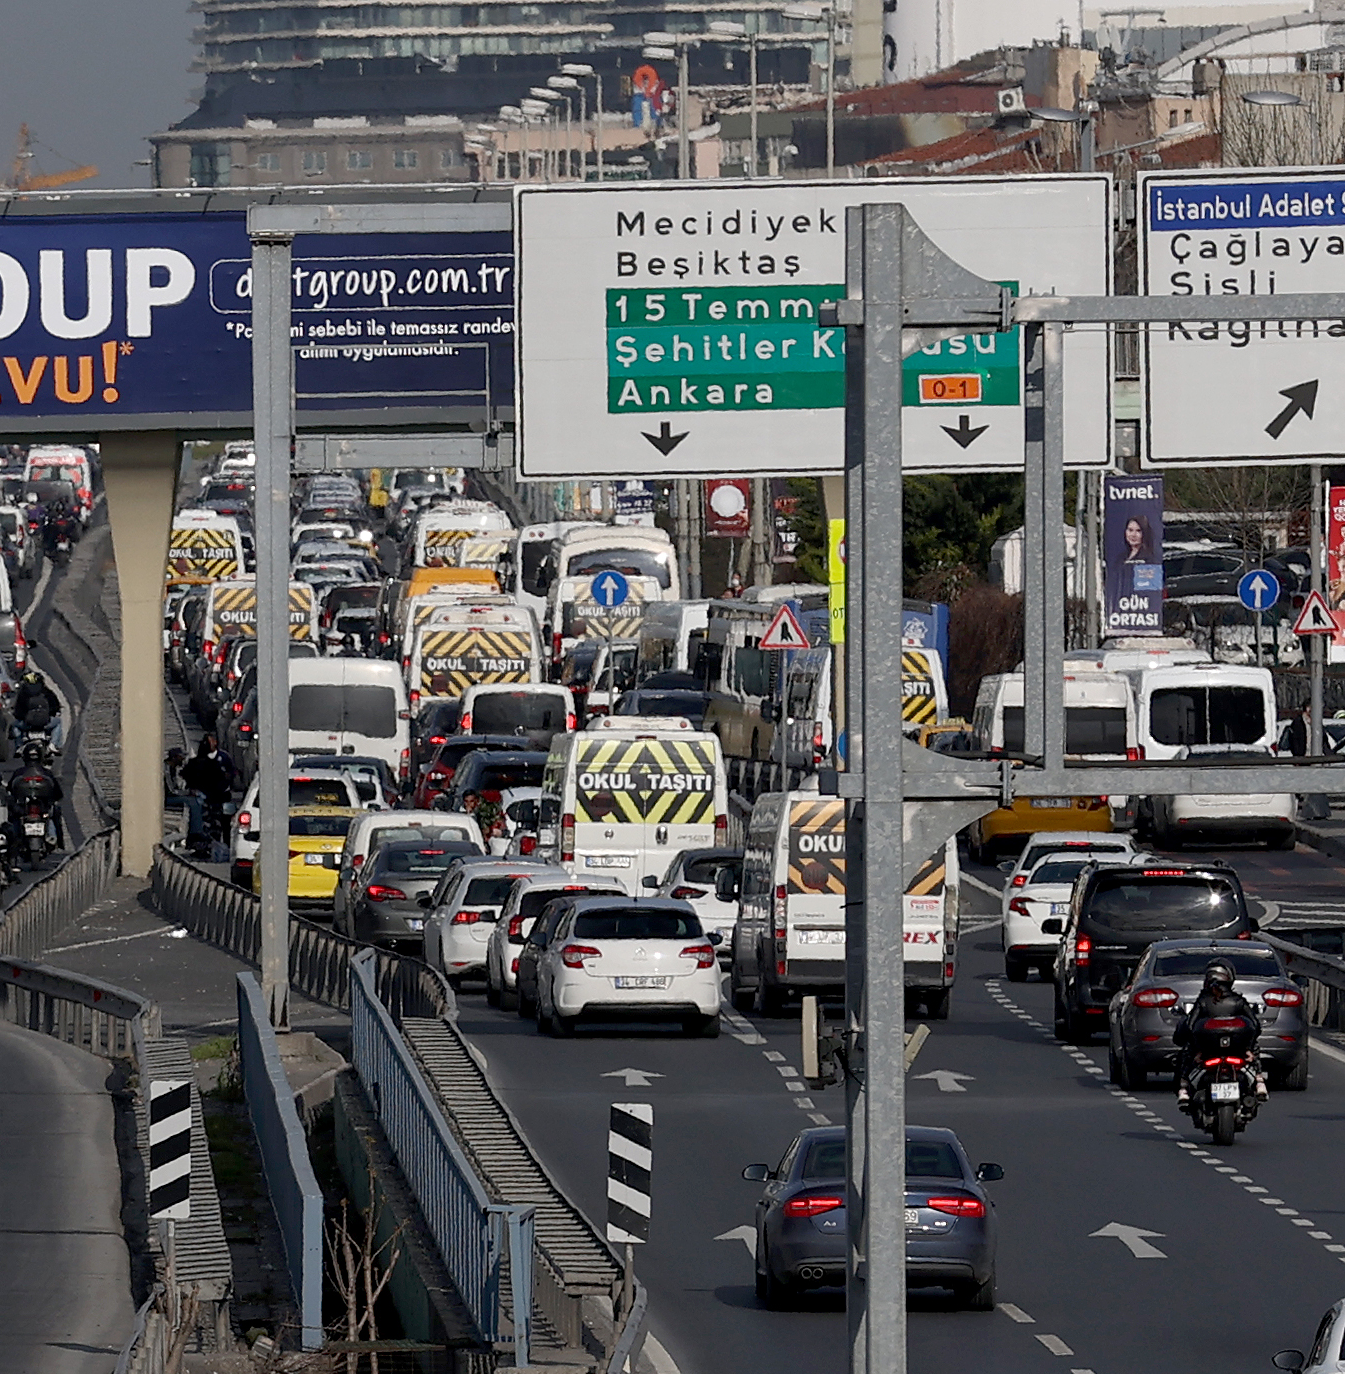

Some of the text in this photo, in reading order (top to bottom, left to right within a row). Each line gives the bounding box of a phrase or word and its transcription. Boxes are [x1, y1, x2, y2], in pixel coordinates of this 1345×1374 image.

[1156, 190, 1335, 221] İstanbul Adalet
[617, 250, 801, 279] Beşiktaş
[236, 262, 511, 309] dtgroup.com.tr
[615, 293, 815, 323] 15 Temm
[308, 319, 361, 337] sebebi
[367, 319, 386, 336] ile
[391, 319, 459, 337] temassız
[615, 333, 797, 367] Şehitler
[617, 379, 774, 407] Ankara
[1119, 594, 1150, 611] GÜN
[1109, 613, 1159, 627] ORTASI
[426, 658, 466, 671] OKUL
[578, 773, 712, 794] OKUL TAŞITI
[798, 835, 845, 853] OKU
